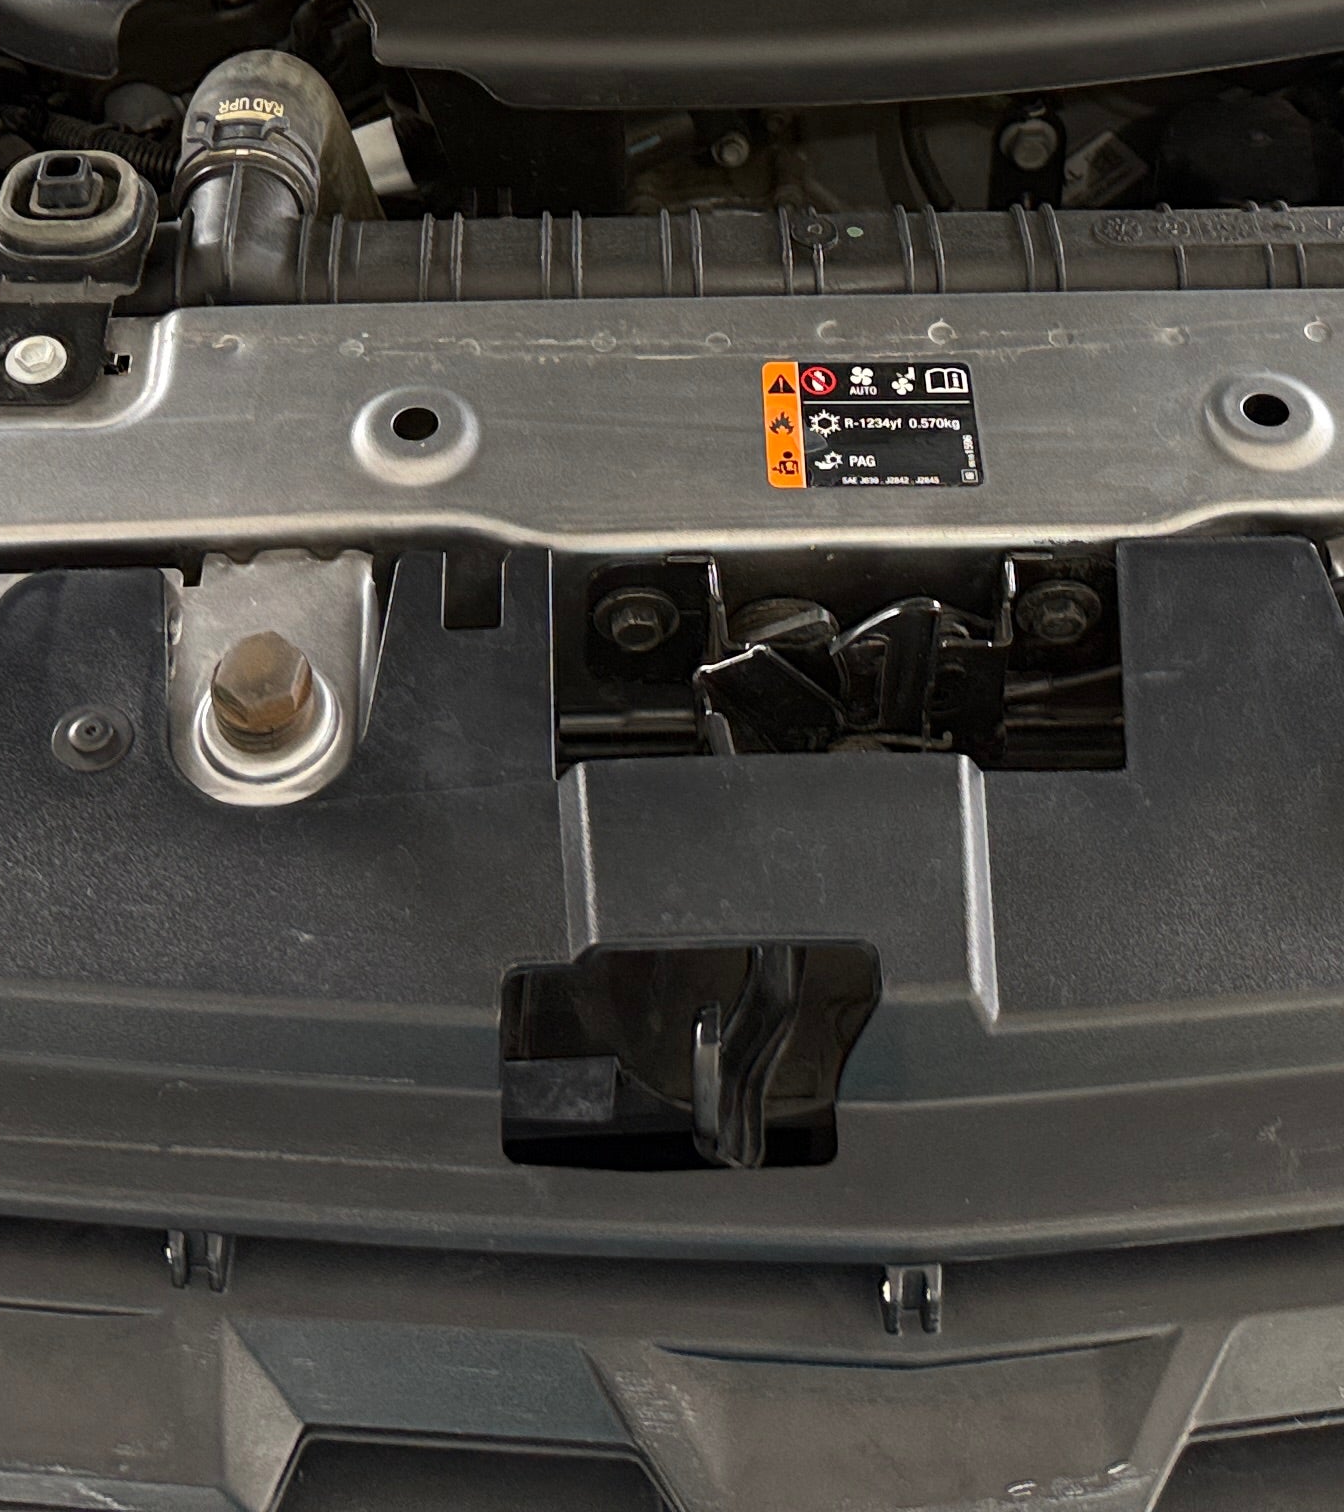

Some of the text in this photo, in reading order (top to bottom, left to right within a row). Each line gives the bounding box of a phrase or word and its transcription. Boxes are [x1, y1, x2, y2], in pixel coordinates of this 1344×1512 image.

[218, 96, 285, 117] RAD UPR
[849, 386, 878, 396] AUTO
[844, 418, 961, 431] R-1234yf 0.570kg
[849, 455, 877, 468] PAG
